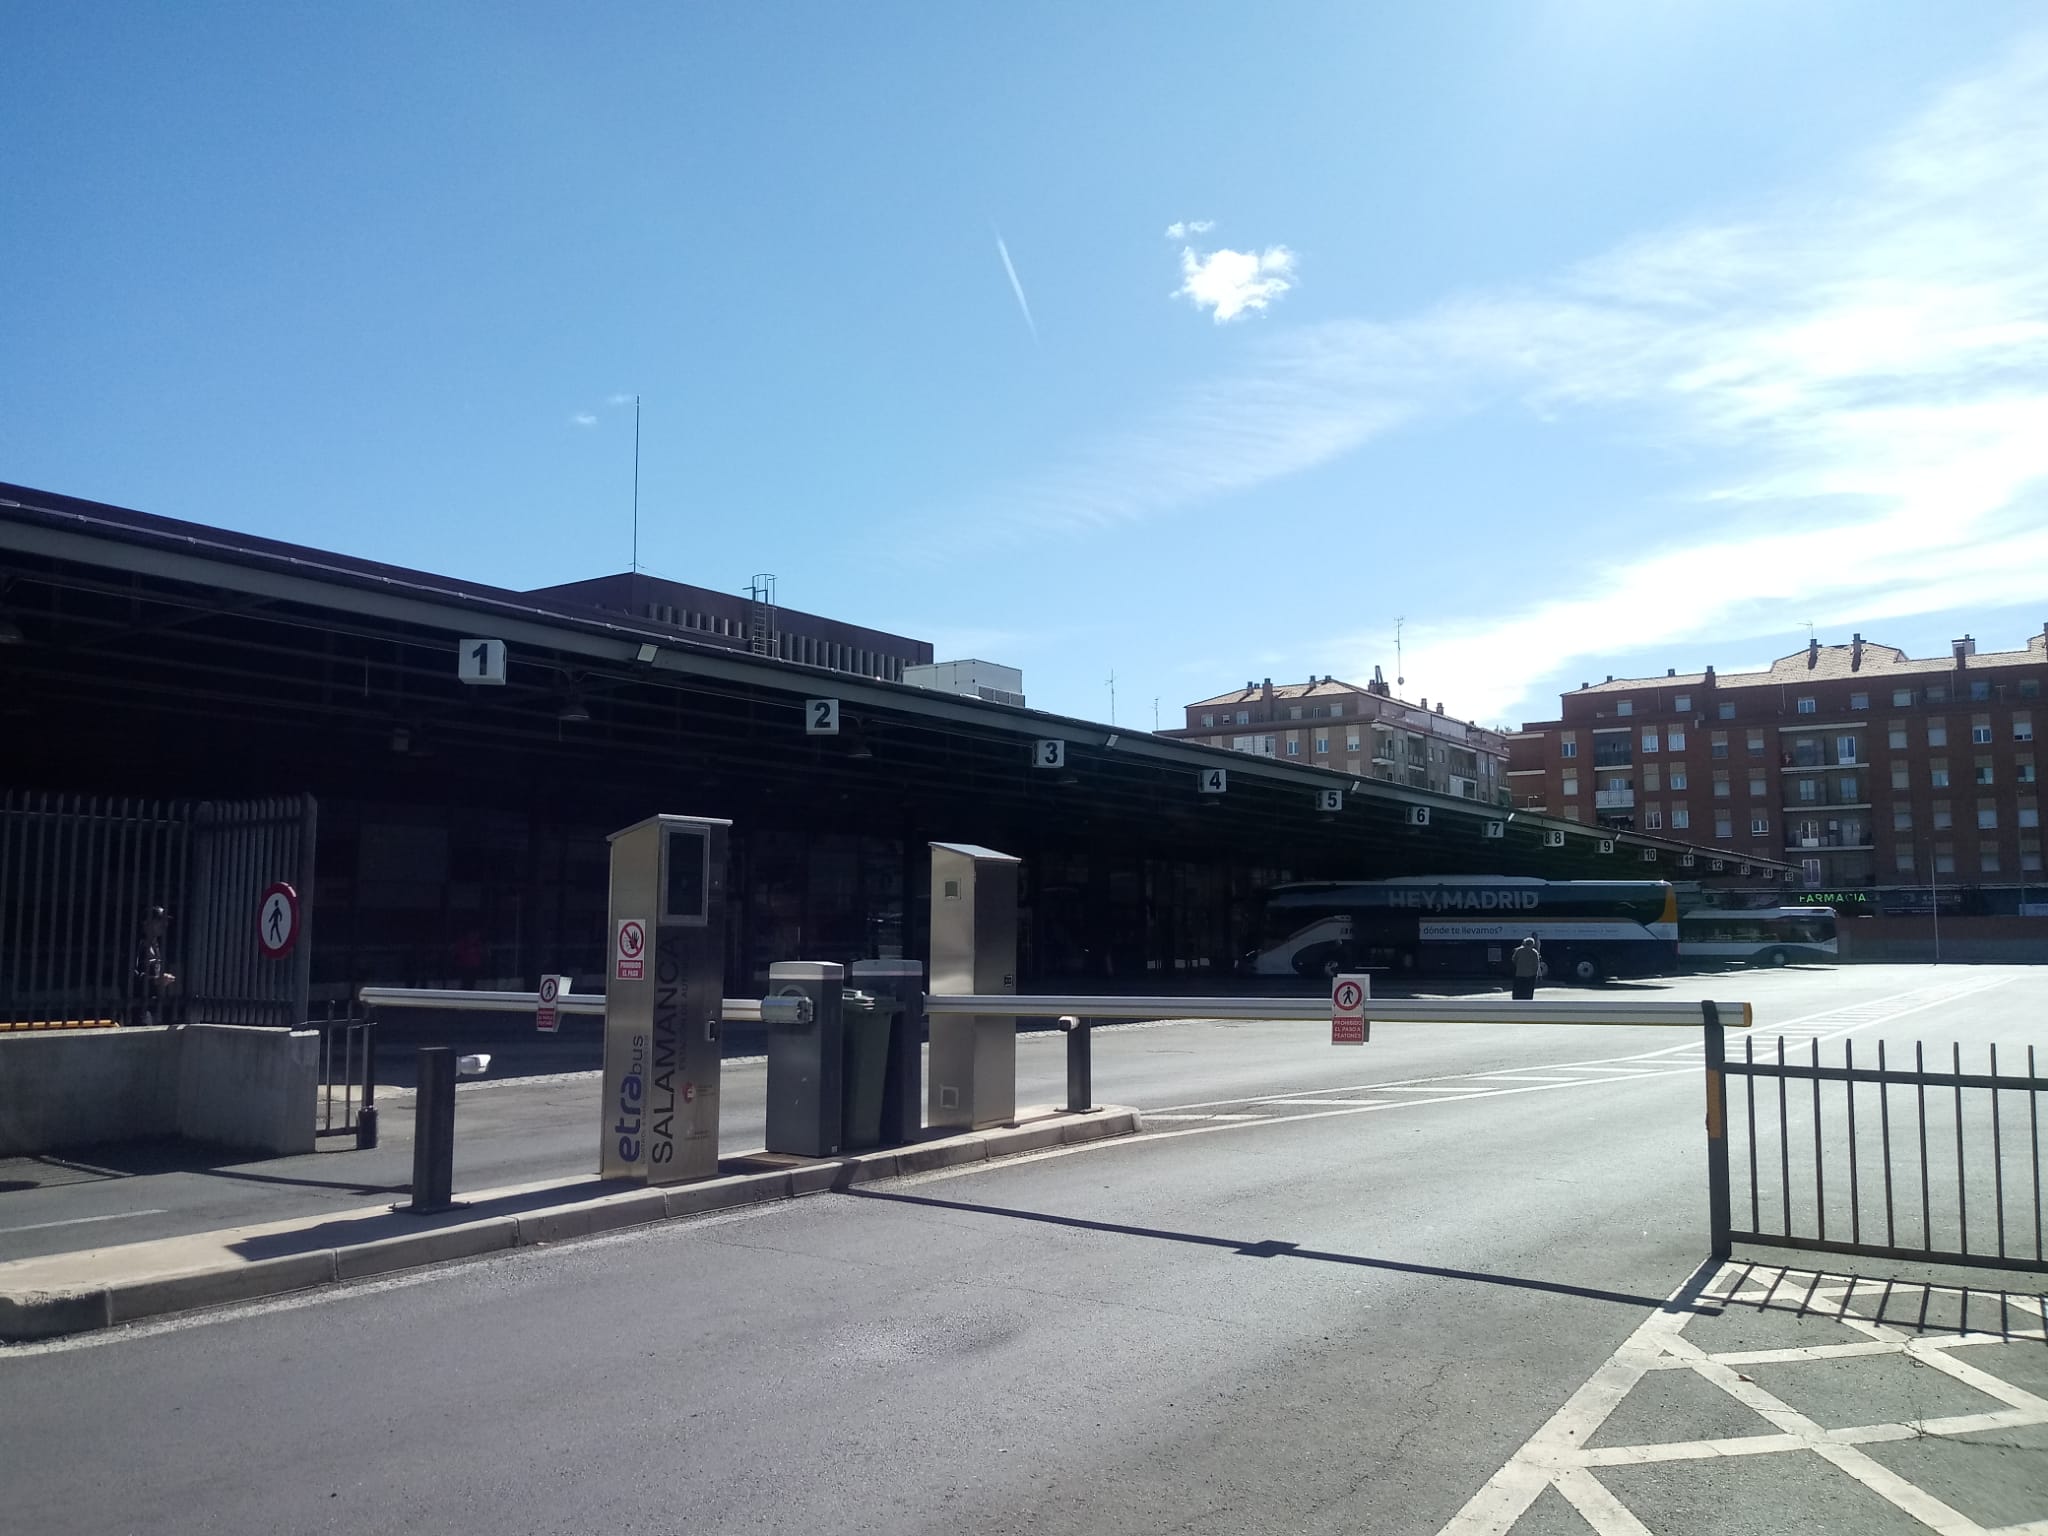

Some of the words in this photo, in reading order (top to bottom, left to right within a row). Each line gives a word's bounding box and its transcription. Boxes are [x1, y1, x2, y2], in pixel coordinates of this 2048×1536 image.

[472, 643, 488, 676] 1
[814, 702, 831, 728] 2
[1045, 742, 1058, 764] 3
[1208, 771, 1222, 790] 4
[1327, 792, 1338, 808] 5
[1416, 808, 1426, 823] 6
[1492, 823, 1500, 836] 7
[1554, 832, 1562, 844] 8
[1603, 841, 1611, 852] 9
[1646, 849, 1656, 860] 10
[1684, 856, 1693, 866] 11
[1713, 860, 1722, 869] 12
[1799, 893, 1867, 903] FARMACIA
[1423, 925, 1449, 935] dónde
[1451, 926, 1460, 935] te
[1461, 925, 1503, 935] llevamos?
[652, 936, 679, 1164] SALAMANCA
